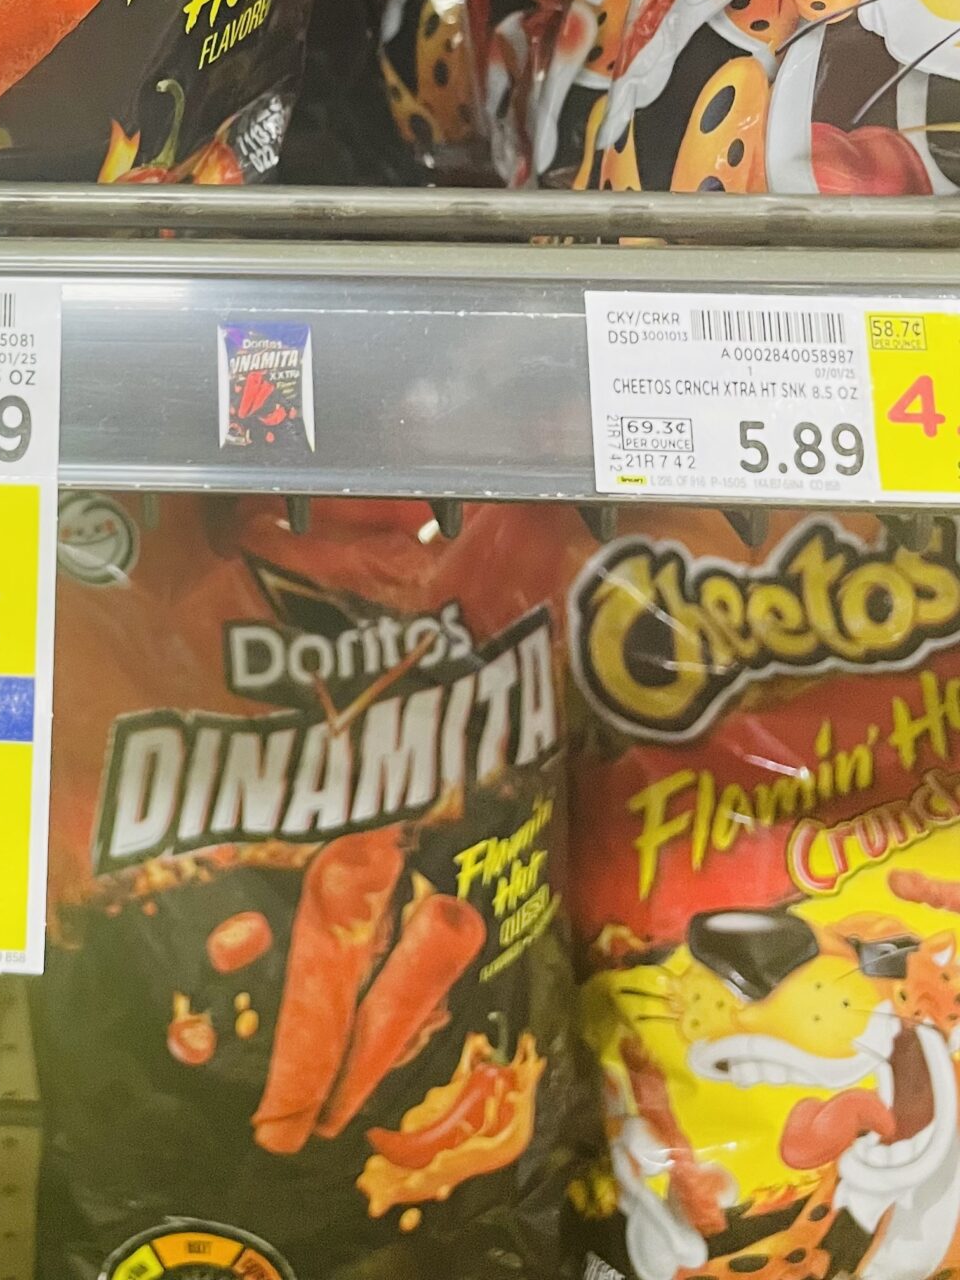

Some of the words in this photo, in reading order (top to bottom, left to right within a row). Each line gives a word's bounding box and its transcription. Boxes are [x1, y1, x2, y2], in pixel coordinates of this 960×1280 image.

[606, 311, 680, 326] CKY/CRKR
[608, 330, 639, 344] DSD
[642, 330, 688, 342] 3001013
[9, 369, 37, 386] OZ
[613, 378, 672, 395] CHEETOS
[676, 379, 719, 396] CRNCH
[723, 381, 757, 397] XTRA
[761, 382, 777, 397] HT
[781, 382, 807, 399] SNK
[812, 386, 833, 400] 8.5
[838, 386, 859, 400] OZ
[626, 438, 648, 447] PER
[651, 439, 691, 449] OUNCE
[739, 420, 865, 476] 5.89
[590, 533, 960, 719] Cheetos
[230, 605, 473, 687] Doritos
[109, 626, 556, 859] DINAMITA
